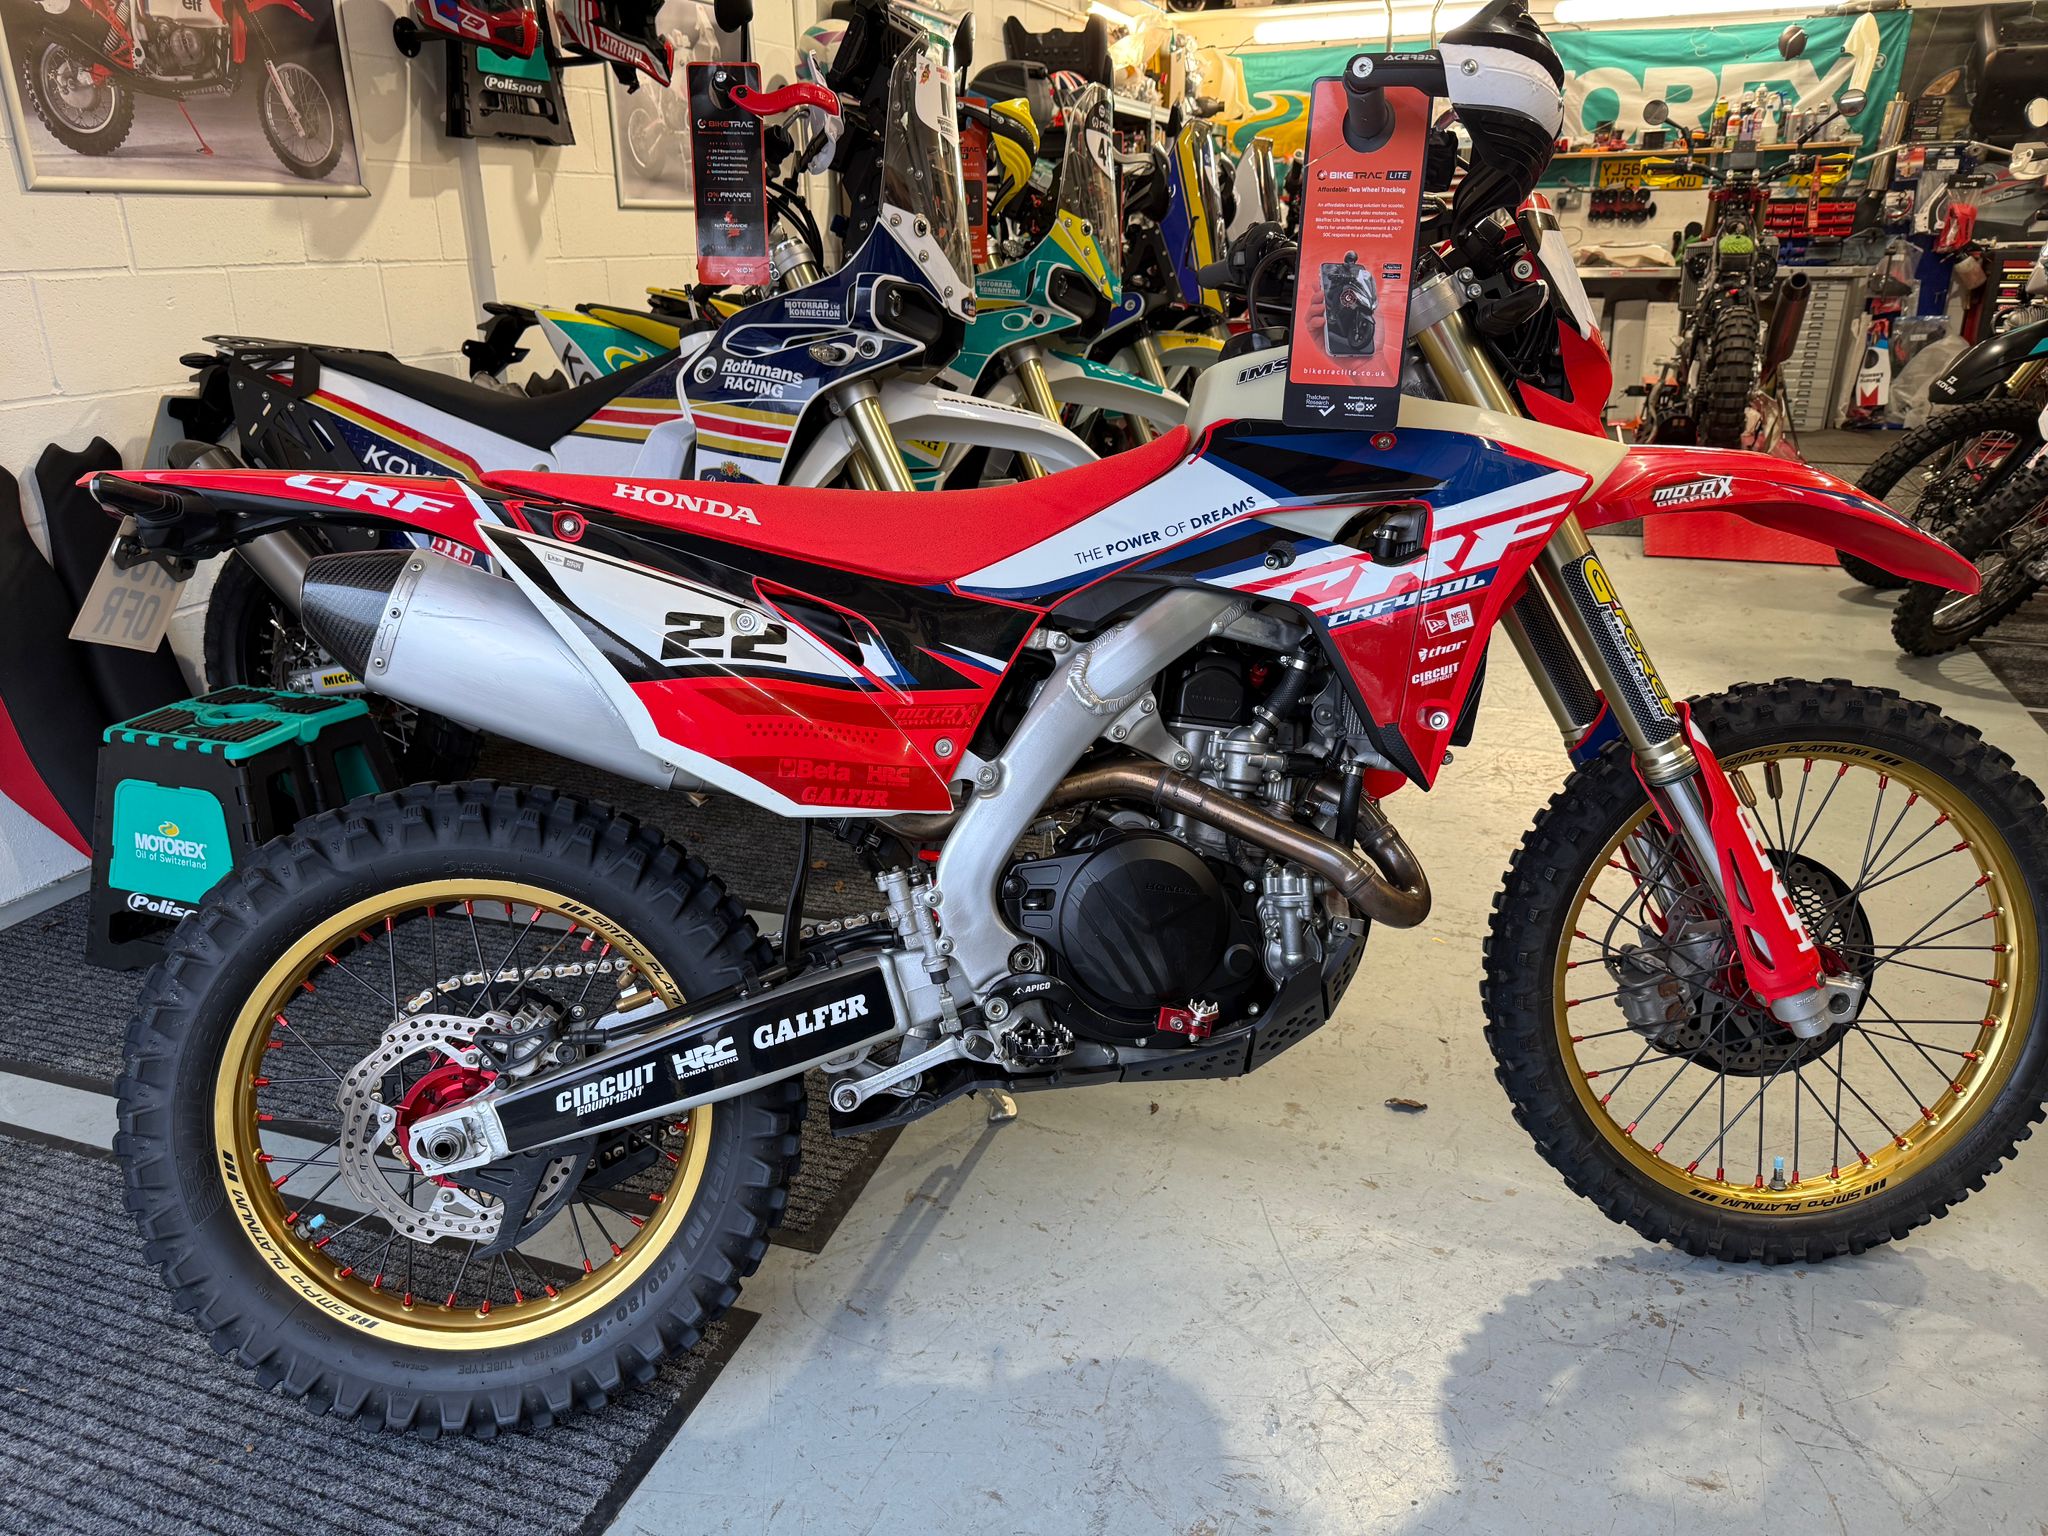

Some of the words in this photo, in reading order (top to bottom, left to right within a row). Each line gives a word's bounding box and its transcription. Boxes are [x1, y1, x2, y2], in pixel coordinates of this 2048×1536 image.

[1383, 54, 1437, 62] ACERBIS
[487, 75, 543, 95] Polisport
[708, 120, 754, 129] BIKETRAC
[1329, 171, 1384, 180] BIKETRAC
[1389, 171, 1408, 179] LITE
[784, 301, 829, 311] MOTORRAD
[789, 308, 841, 318] KONNECTION
[720, 358, 804, 385] Rothmans
[1237, 356, 1287, 385] IMS
[1303, 368, 1386, 378] biketraclite.co.uk
[723, 376, 784, 399] RACING
[1935, 379, 1957, 396] KOVE
[284, 474, 455, 513] CRF
[612, 482, 762, 526] HONDA
[1073, 546, 1104, 565] THE
[1105, 530, 1162, 556] POWER
[1164, 521, 1187, 537] OF
[1189, 496, 1257, 530] DREAMS
[432, 537, 475, 565] D.I.D
[1281, 502, 1566, 612] CRF
[1450, 609, 1468, 620] NEW
[1452, 617, 1470, 627] ERA
[660, 611, 788, 665] 22
[1428, 640, 1467, 658] thor
[323, 673, 357, 687] MICH
[1411, 662, 1460, 684] CIRCUIT
[1786, 744, 1868, 758] PLATINUM
[796, 760, 851, 783] Beta
[867, 765, 910, 783] HRC
[801, 786, 889, 807] GALFER
[134, 832, 208, 861] MOTOREX
[135, 849, 148, 860] Oil
[149, 851, 158, 861] of
[159, 853, 207, 870] Switzerland
[588, 915, 645, 957] SMPro
[1025, 982, 1051, 995] APICO
[753, 993, 869, 1050] GALFER
[671, 1036, 738, 1075] HRC
[677, 1063, 706, 1080] HONDA
[707, 1055, 740, 1073] RACING
[555, 1061, 657, 1113] CIRCUIT
[576, 1085, 645, 1117] EQUIPMENT
[1720, 1197, 1800, 1213] PLATINUM
[1807, 1188, 1862, 1208] SMPro
[232, 1188, 291, 1271] PLATINUM
[290, 1274, 352, 1317] SMPro
[456, 1359, 515, 1376] TUBETYPE
